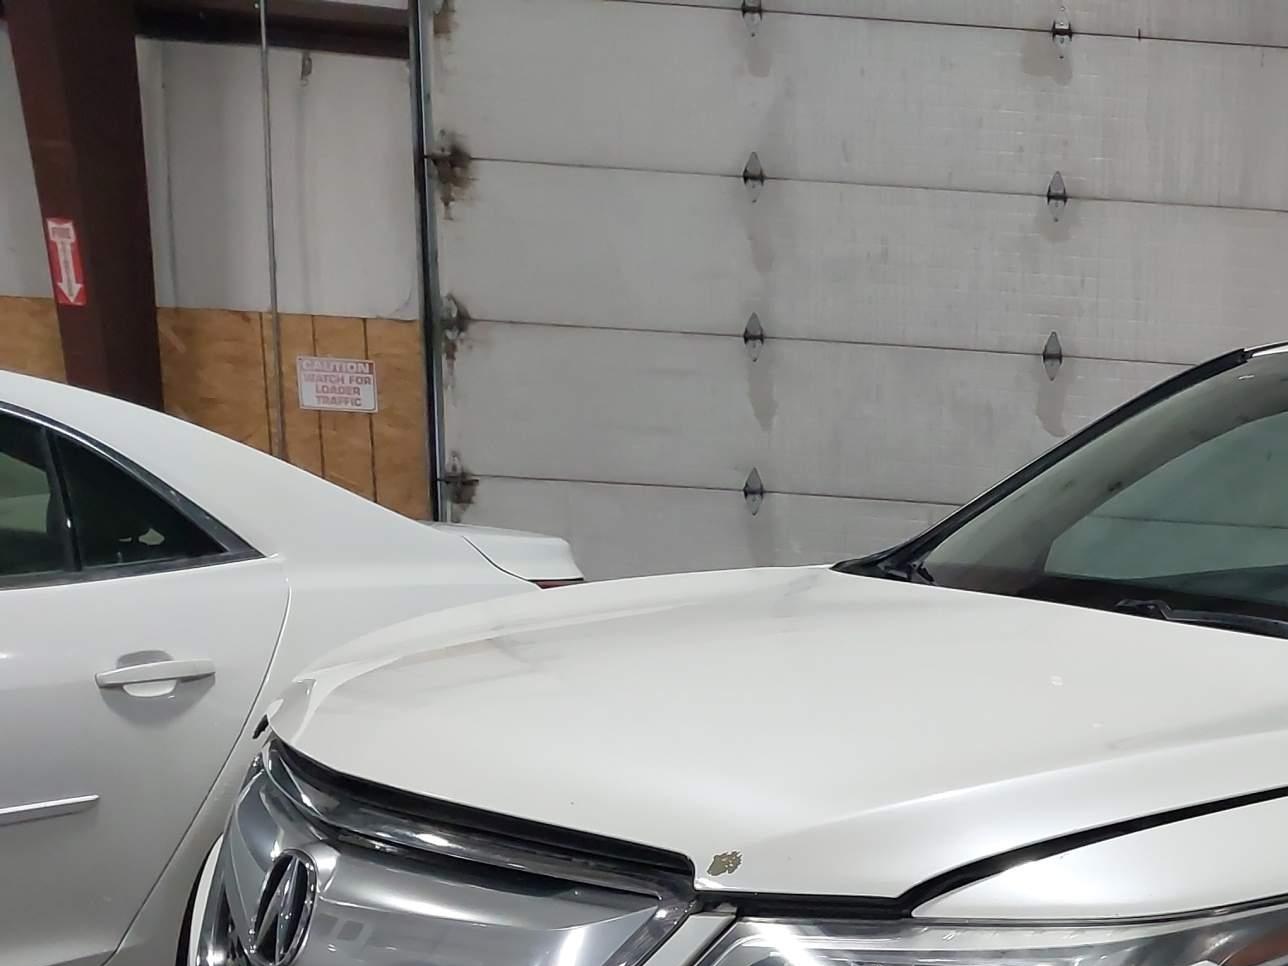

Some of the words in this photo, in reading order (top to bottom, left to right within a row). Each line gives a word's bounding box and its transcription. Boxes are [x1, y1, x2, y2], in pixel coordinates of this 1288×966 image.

[303, 360, 369, 374] CAUTION
[304, 373, 345, 385] WATCH
[349, 375, 371, 385] FOR
[316, 384, 361, 396] LOADER
[316, 395, 362, 407] TRAFFIC
